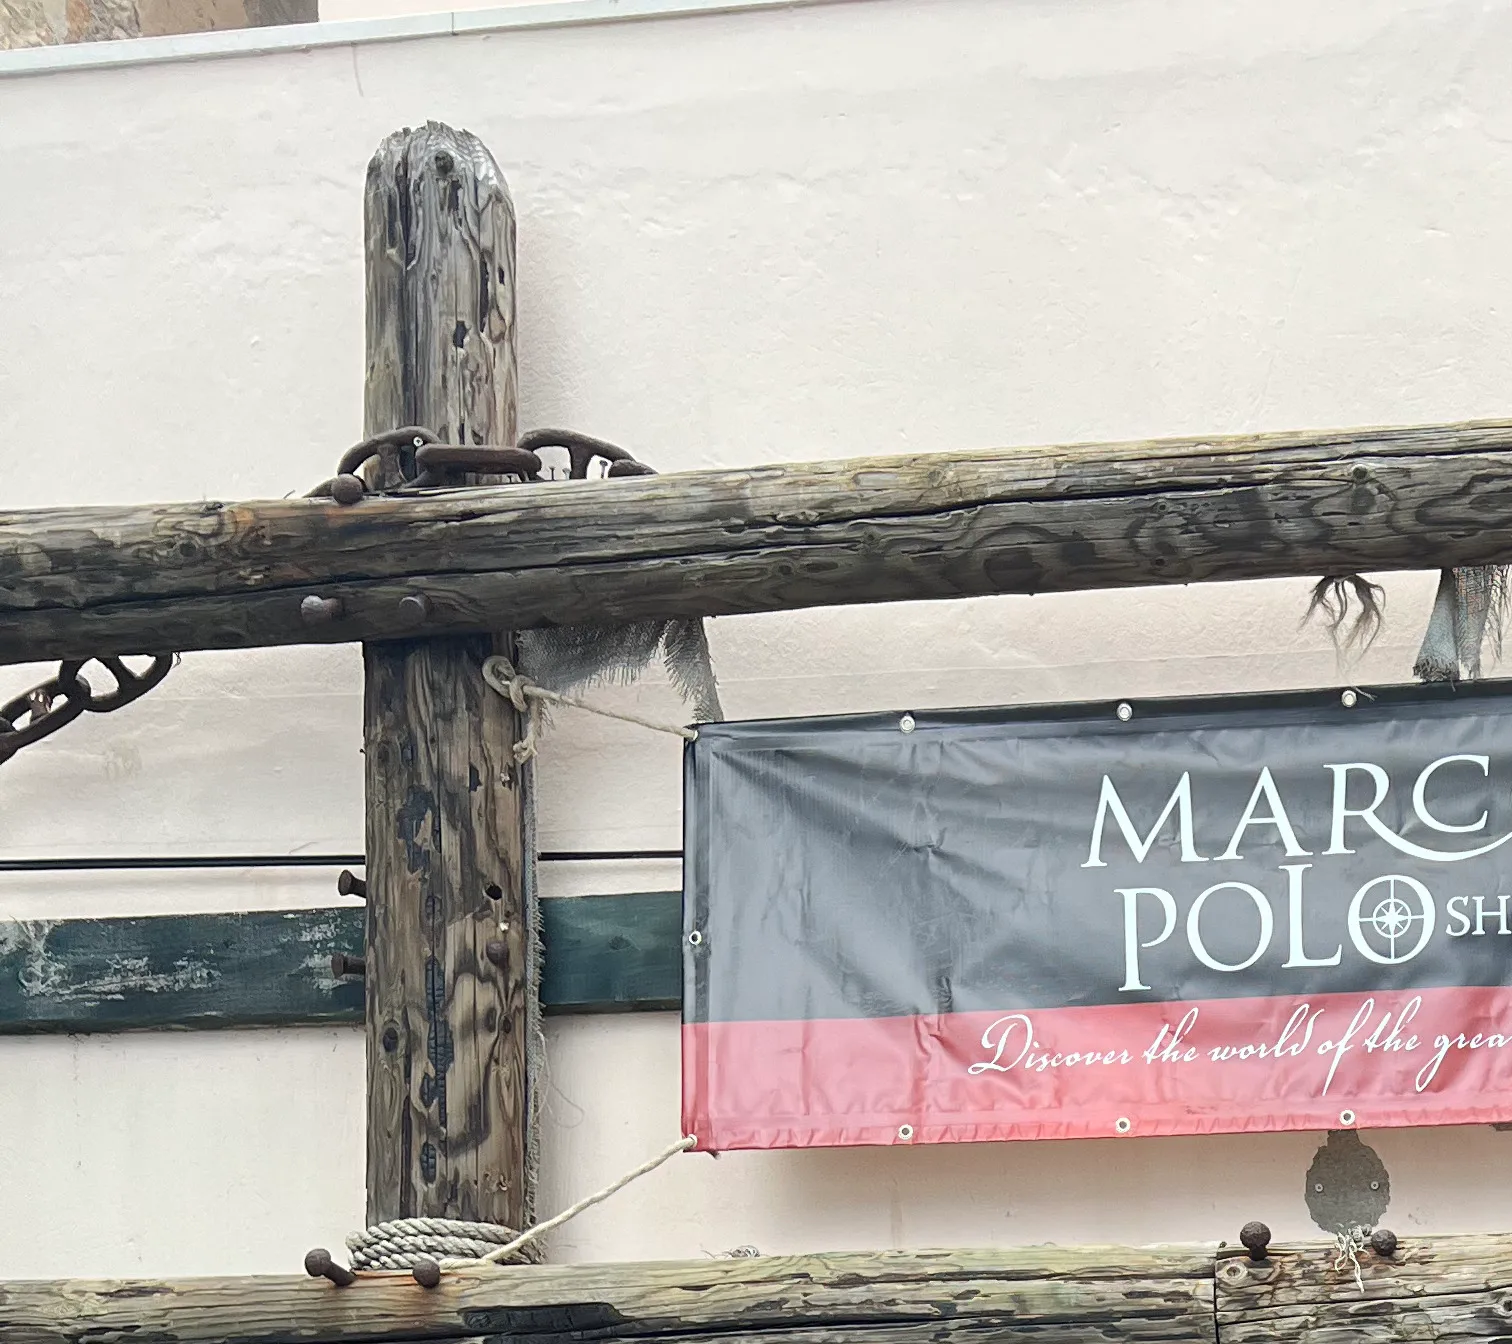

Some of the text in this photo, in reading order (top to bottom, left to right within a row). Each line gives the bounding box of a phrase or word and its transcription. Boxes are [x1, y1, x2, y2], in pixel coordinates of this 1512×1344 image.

[1114, 864, 1436, 992] POLO
[968, 1013, 1134, 1075] Discover
[1141, 1006, 1199, 1064] the
[1207, 1003, 1325, 1062] world
[1316, 997, 1375, 1097] of
[1361, 995, 1422, 1053] the
